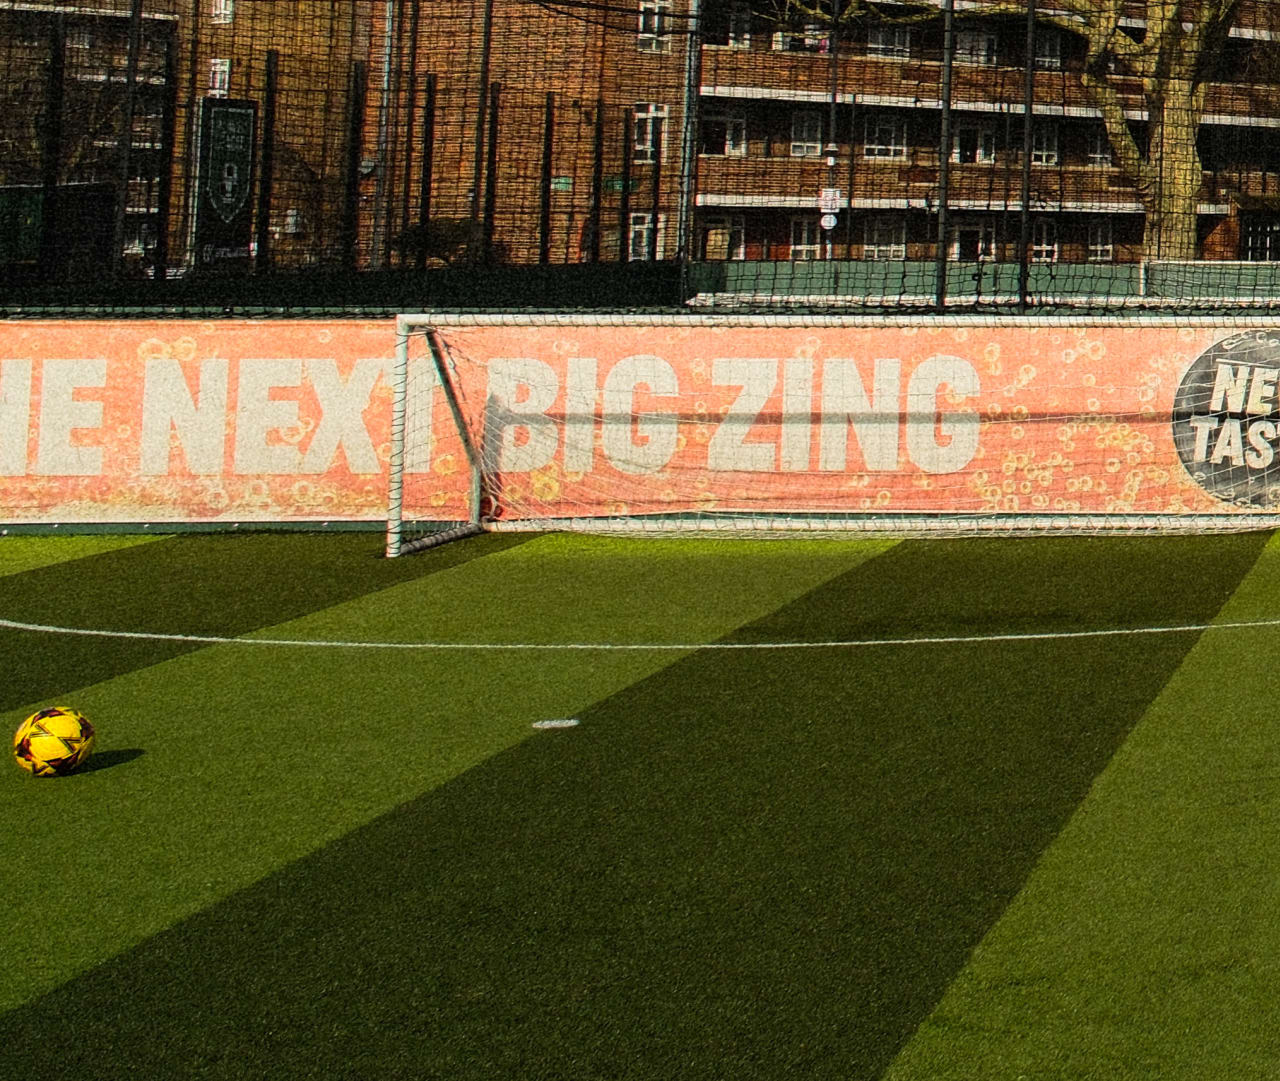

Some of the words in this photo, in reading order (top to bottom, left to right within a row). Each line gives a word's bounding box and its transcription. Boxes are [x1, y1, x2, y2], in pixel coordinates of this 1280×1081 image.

[138, 358, 443, 476] NEXT
[481, 354, 679, 476] BIG
[707, 354, 981, 475] ZING
